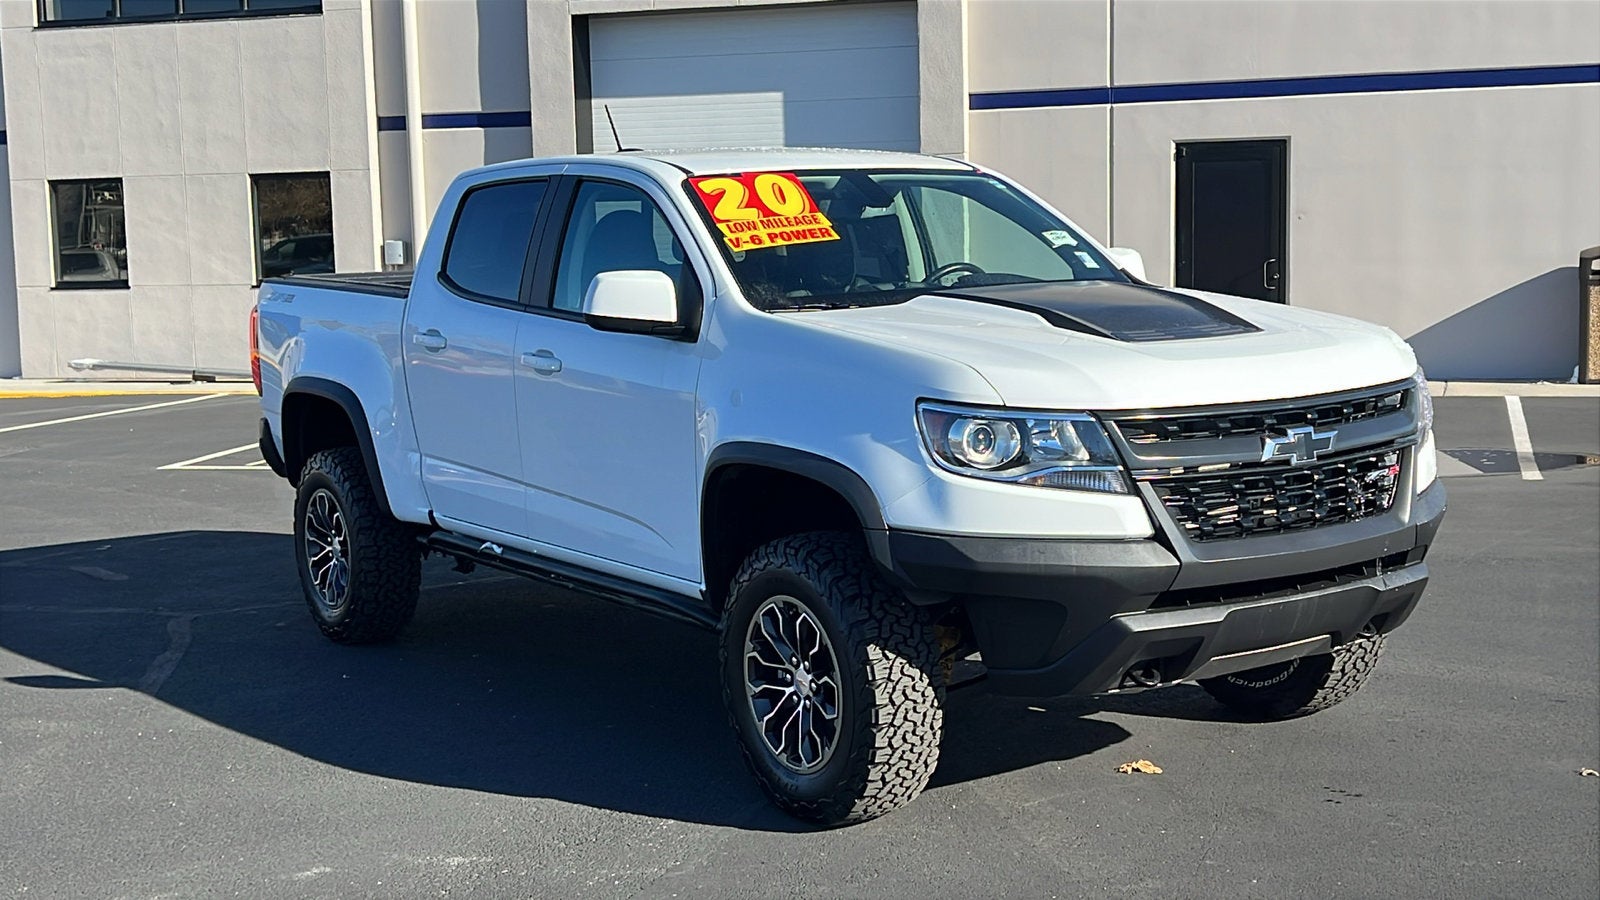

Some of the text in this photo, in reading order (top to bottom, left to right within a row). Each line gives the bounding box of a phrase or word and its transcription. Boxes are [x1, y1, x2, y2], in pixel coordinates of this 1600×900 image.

[697, 173, 810, 221] 20
[725, 214, 821, 234] LOW MILEAGE
[728, 227, 834, 249] V-6 POWER
